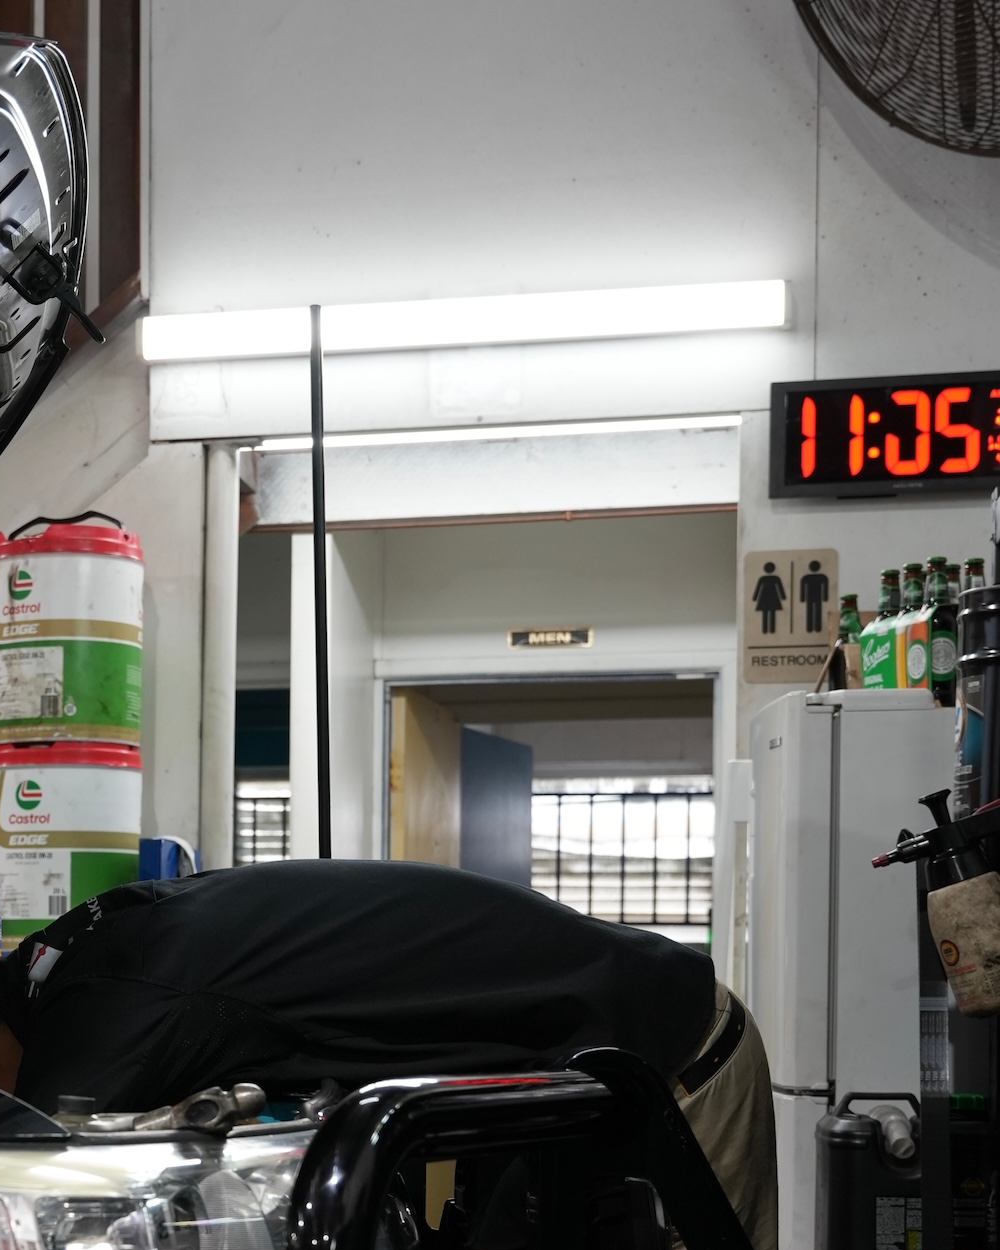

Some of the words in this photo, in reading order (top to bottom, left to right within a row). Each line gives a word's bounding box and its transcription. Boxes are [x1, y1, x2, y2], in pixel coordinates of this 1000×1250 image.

[801, 387, 981, 478] 11:05
[2, 602, 41, 616] Castrol
[2, 623, 40, 637] EDGE
[528, 631, 571, 645] MEN
[751, 654, 829, 667] RESTROOM
[8, 814, 50, 824] Castrol
[8, 834, 49, 846] EDGE
